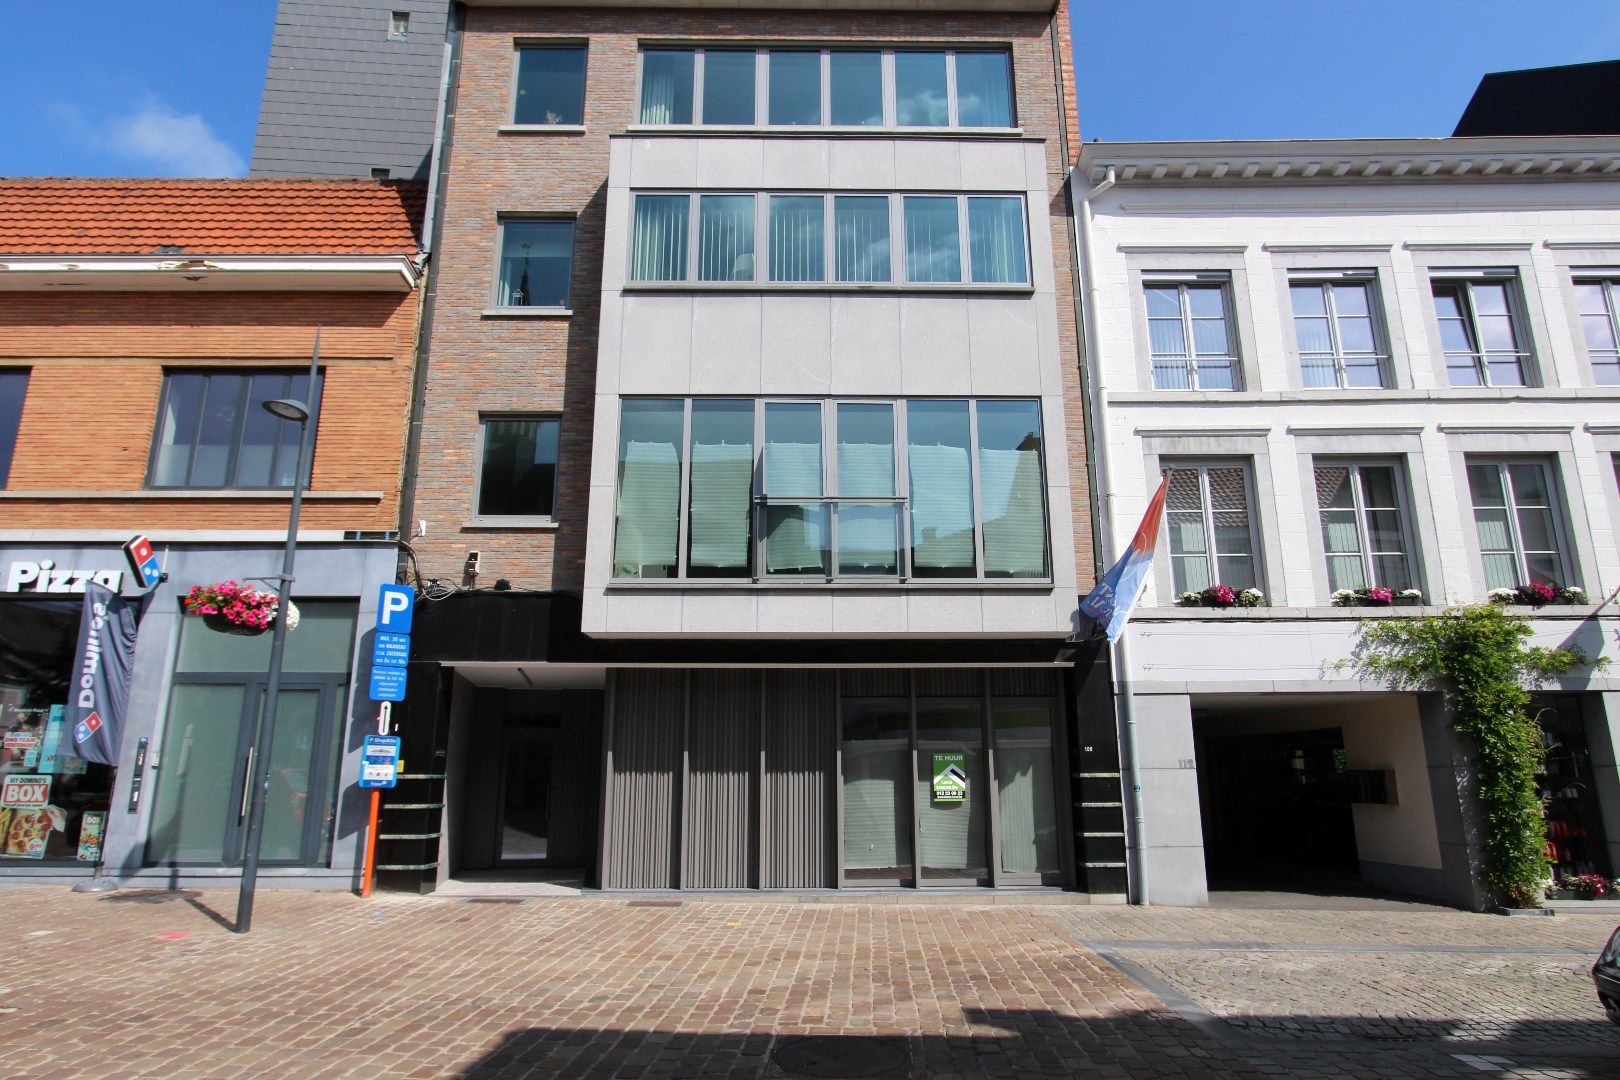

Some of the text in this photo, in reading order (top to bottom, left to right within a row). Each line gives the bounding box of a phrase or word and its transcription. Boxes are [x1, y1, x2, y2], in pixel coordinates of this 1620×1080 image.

[6, 559, 122, 593] Pizza
[382, 591, 408, 624] P
[5, 784, 47, 802] BOX
[86, 816, 101, 824] BOX
